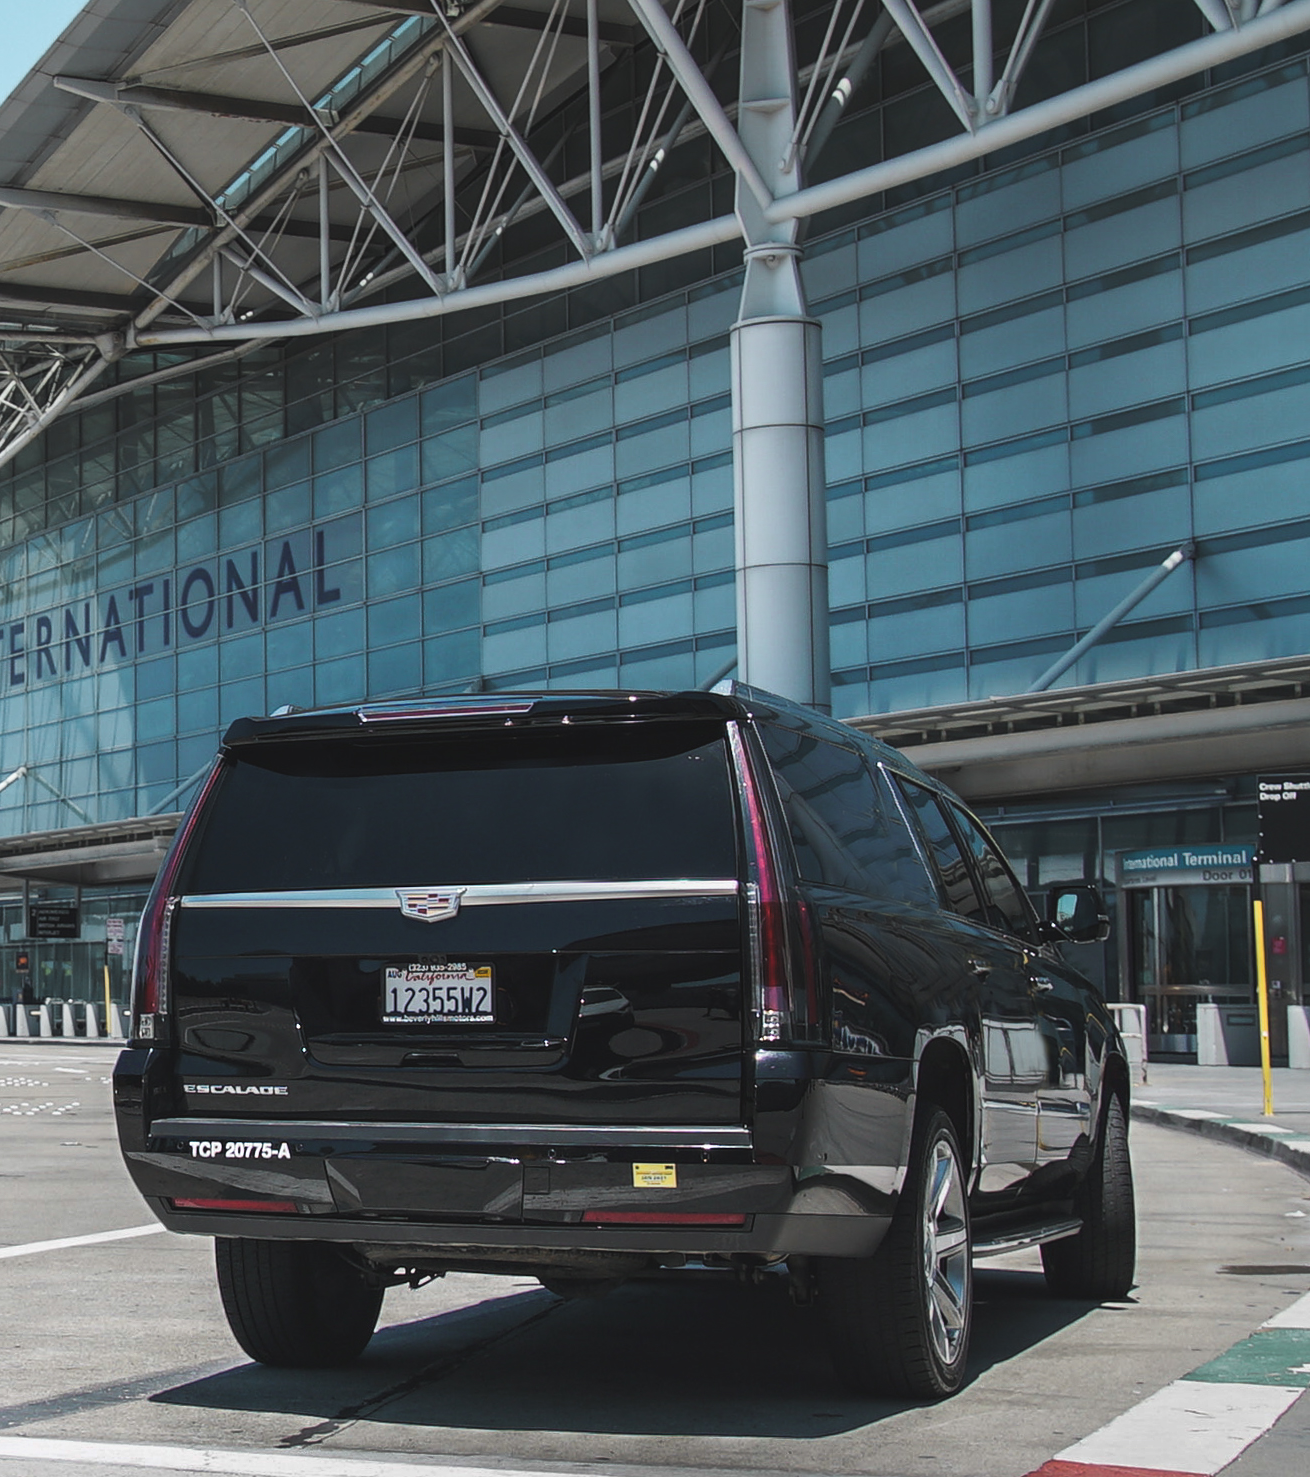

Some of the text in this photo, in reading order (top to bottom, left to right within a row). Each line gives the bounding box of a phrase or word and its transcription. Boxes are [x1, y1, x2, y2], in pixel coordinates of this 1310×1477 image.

[1259, 782, 1282, 791] Crew
[1259, 791, 1297, 802] Drop Off
[1182, 850, 1247, 866] Terminal
[1202, 869, 1234, 881] Door
[404, 970, 475, 985] California
[390, 986, 488, 1013] 12355W2
[383, 1014, 494, 1025] www.beverlyhillsmotors.com
[183, 1084, 289, 1096] ESCALADE
[189, 1141, 291, 1159] TCP 20775-A
